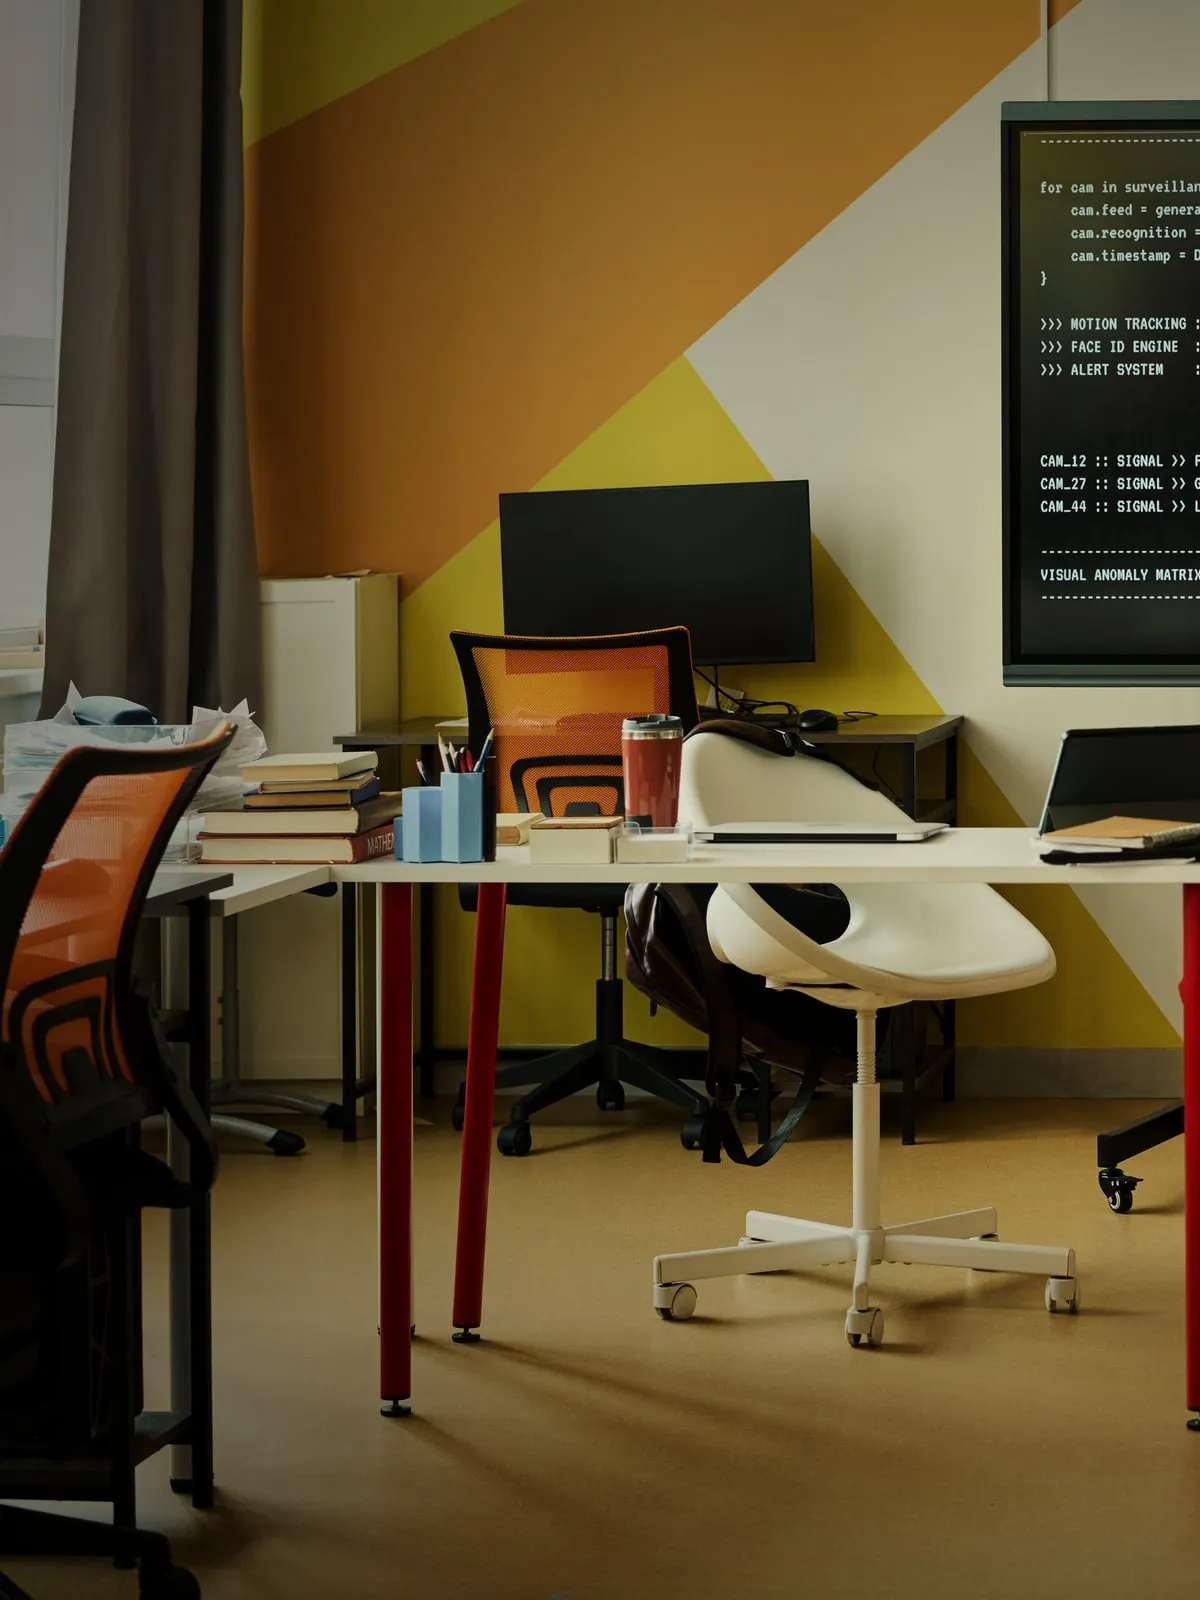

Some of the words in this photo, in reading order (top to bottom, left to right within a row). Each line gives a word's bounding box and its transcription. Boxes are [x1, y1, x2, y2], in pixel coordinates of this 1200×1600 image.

[1041, 181, 1062, 193] for
[1071, 184, 1093, 193] cam
[1102, 181, 1117, 193] in
[1071, 204, 1132, 216] cam.feed
[1071, 226, 1186, 241] cam.recognition
[1071, 250, 1170, 264] cam.timestamp
[1071, 318, 1117, 330] MOTION
[1125, 318, 1186, 330] TRACKING
[1072, 341, 1100, 353] FACE
[1133, 341, 1178, 353] ENGINE
[1071, 364, 1109, 376] ALERT
[1117, 363, 1163, 375] SYSTEM
[1041, 455, 1086, 467] CAM_12
[1117, 455, 1163, 467] SIGNAL
[1041, 478, 1086, 490] CAM_27
[1117, 478, 1163, 490] SIGNAL
[1041, 501, 1086, 512] CAM_44
[1117, 500, 1163, 512] SIGNAL
[1041, 569, 1086, 581] VISUAL
[1095, 569, 1148, 581] ANOMALY
[1156, 569, 1200, 581] MATRIX
